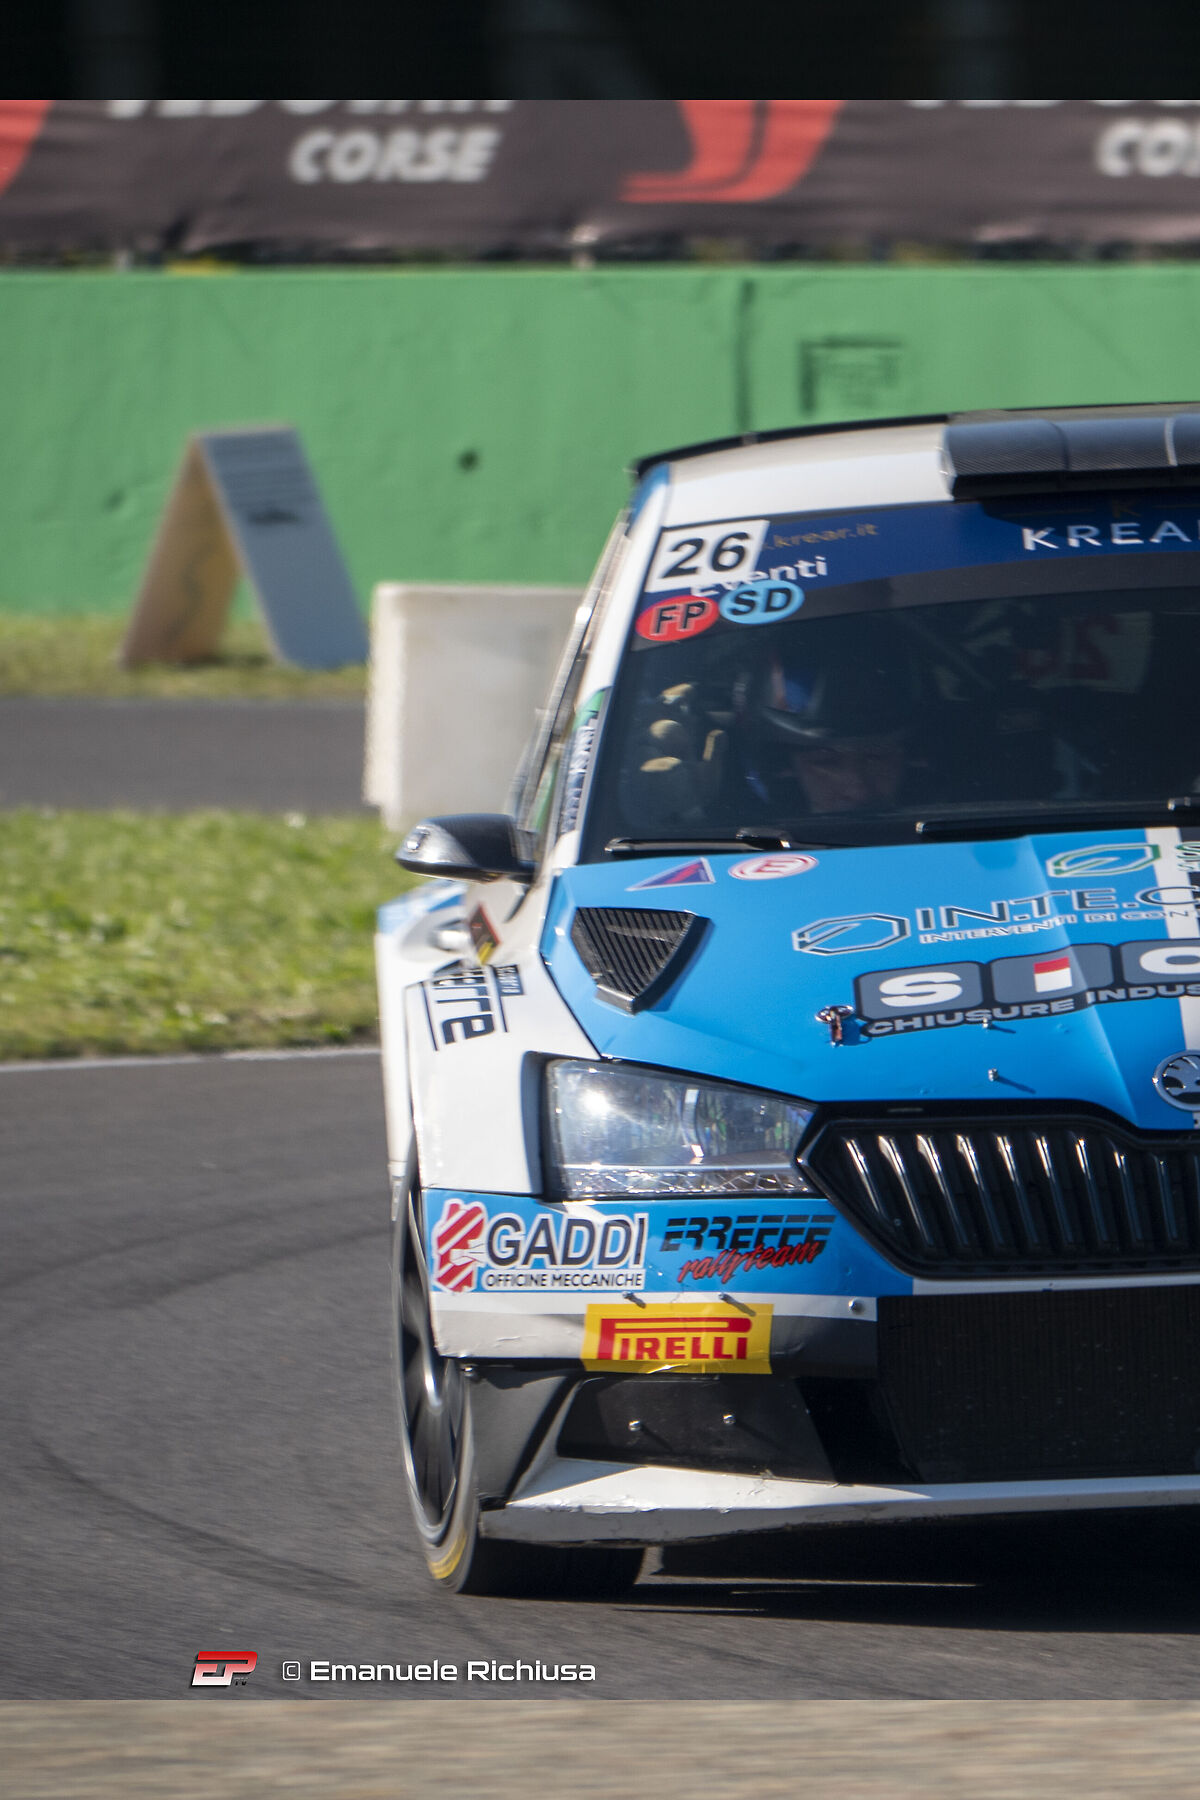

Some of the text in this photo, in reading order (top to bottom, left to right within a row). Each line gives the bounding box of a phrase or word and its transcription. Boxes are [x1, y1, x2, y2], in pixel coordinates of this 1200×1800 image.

[290, 130, 499, 183] CORSE
[762, 523, 879, 550] .krear.it
[662, 532, 752, 578] 26
[651, 601, 708, 634] FP
[731, 587, 793, 616] SD
[919, 913, 1078, 944] INTERVENTI
[1084, 911, 1117, 923] DI
[869, 998, 1075, 1034] CHIUSURE
[487, 1216, 645, 1267] GADDI
[486, 1273, 643, 1288] OFFICINE MECCANICHE
[597, 1317, 753, 1360] PIRELLI
